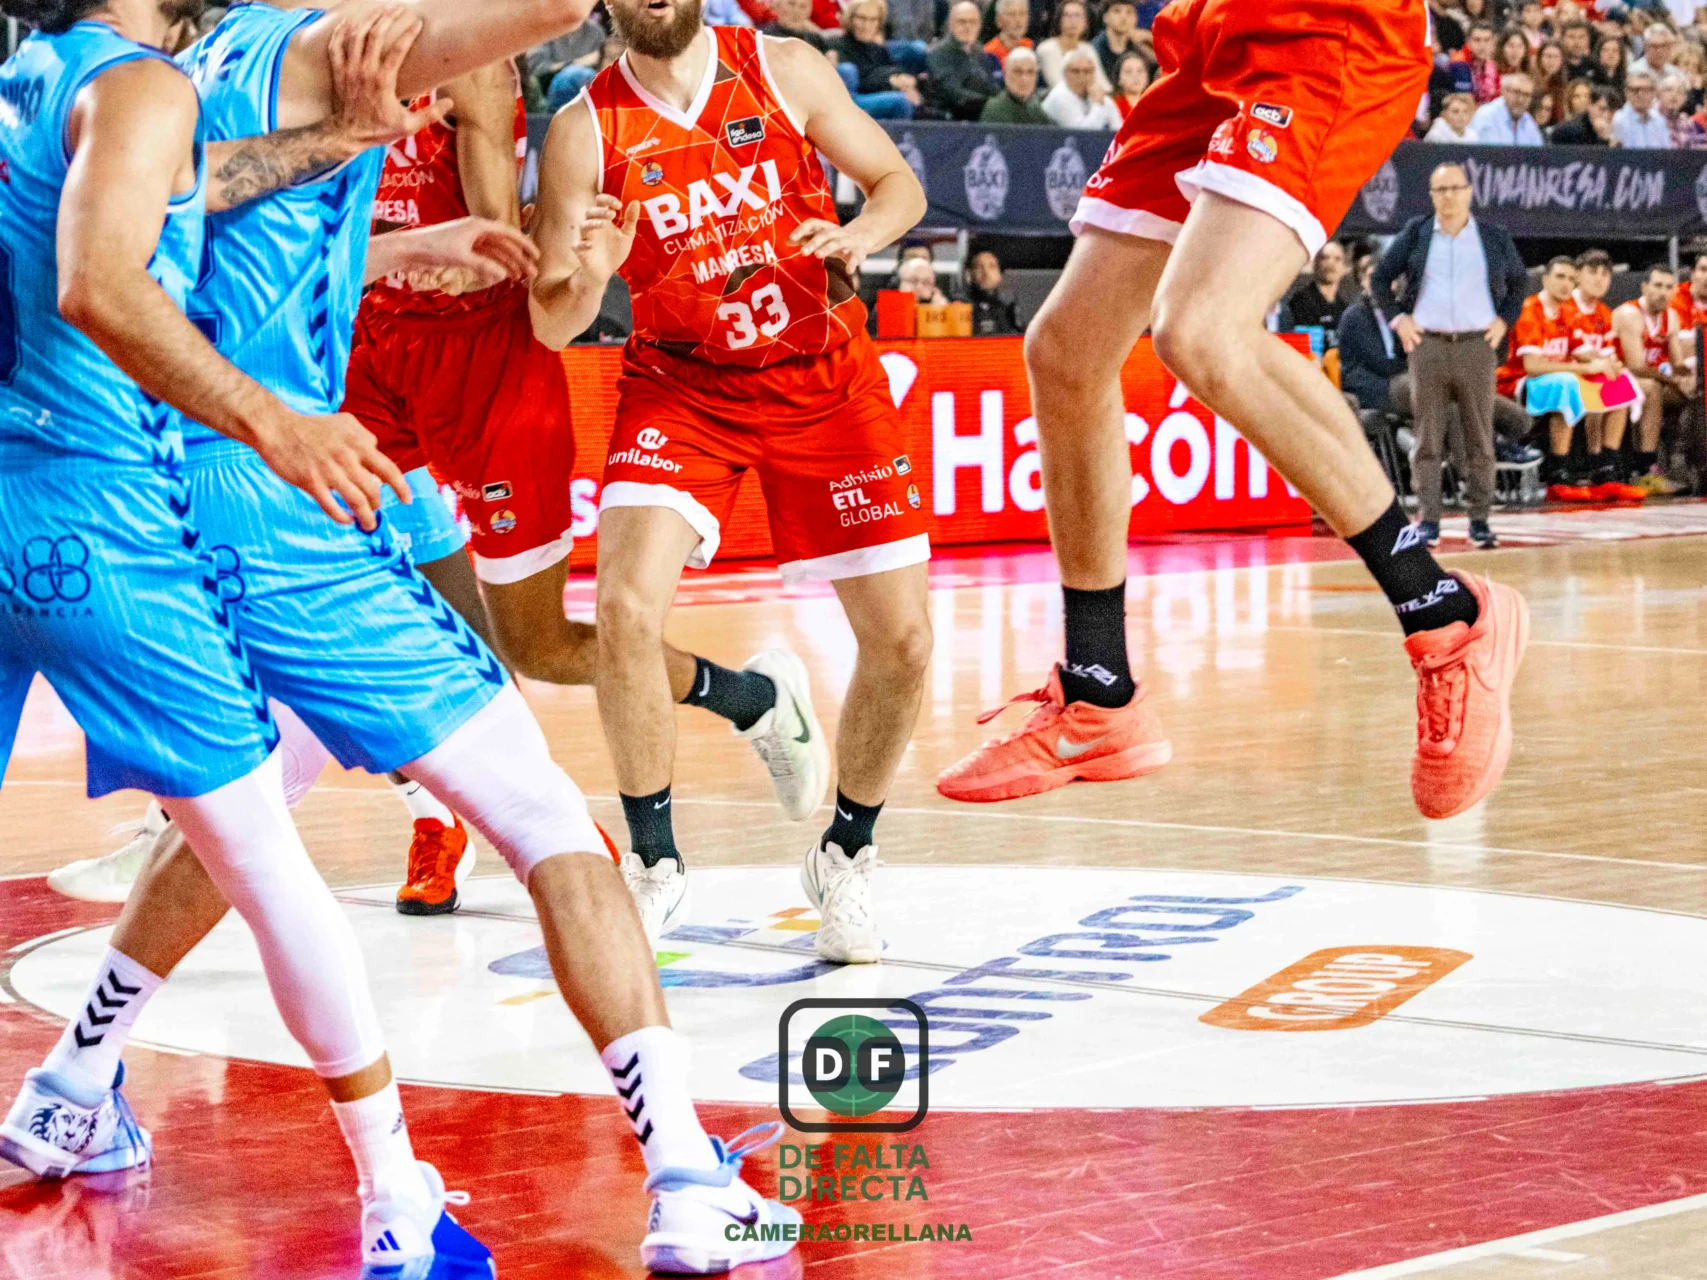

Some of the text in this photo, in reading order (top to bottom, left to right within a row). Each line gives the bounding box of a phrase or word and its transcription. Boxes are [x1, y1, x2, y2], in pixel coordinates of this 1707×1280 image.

[642, 158, 782, 240] BAXI
[1466, 158, 1665, 211] XIMANRESA.COM
[663, 203, 784, 255] CLIMATIZACIÓN
[691, 240, 777, 284] MANRESA
[717, 283, 790, 350] 33
[608, 448, 683, 474] unilabor
[832, 488, 872, 511] ETL
[840, 501, 905, 528] GLOBAL
[1246, 953, 1433, 1021] GROUP
